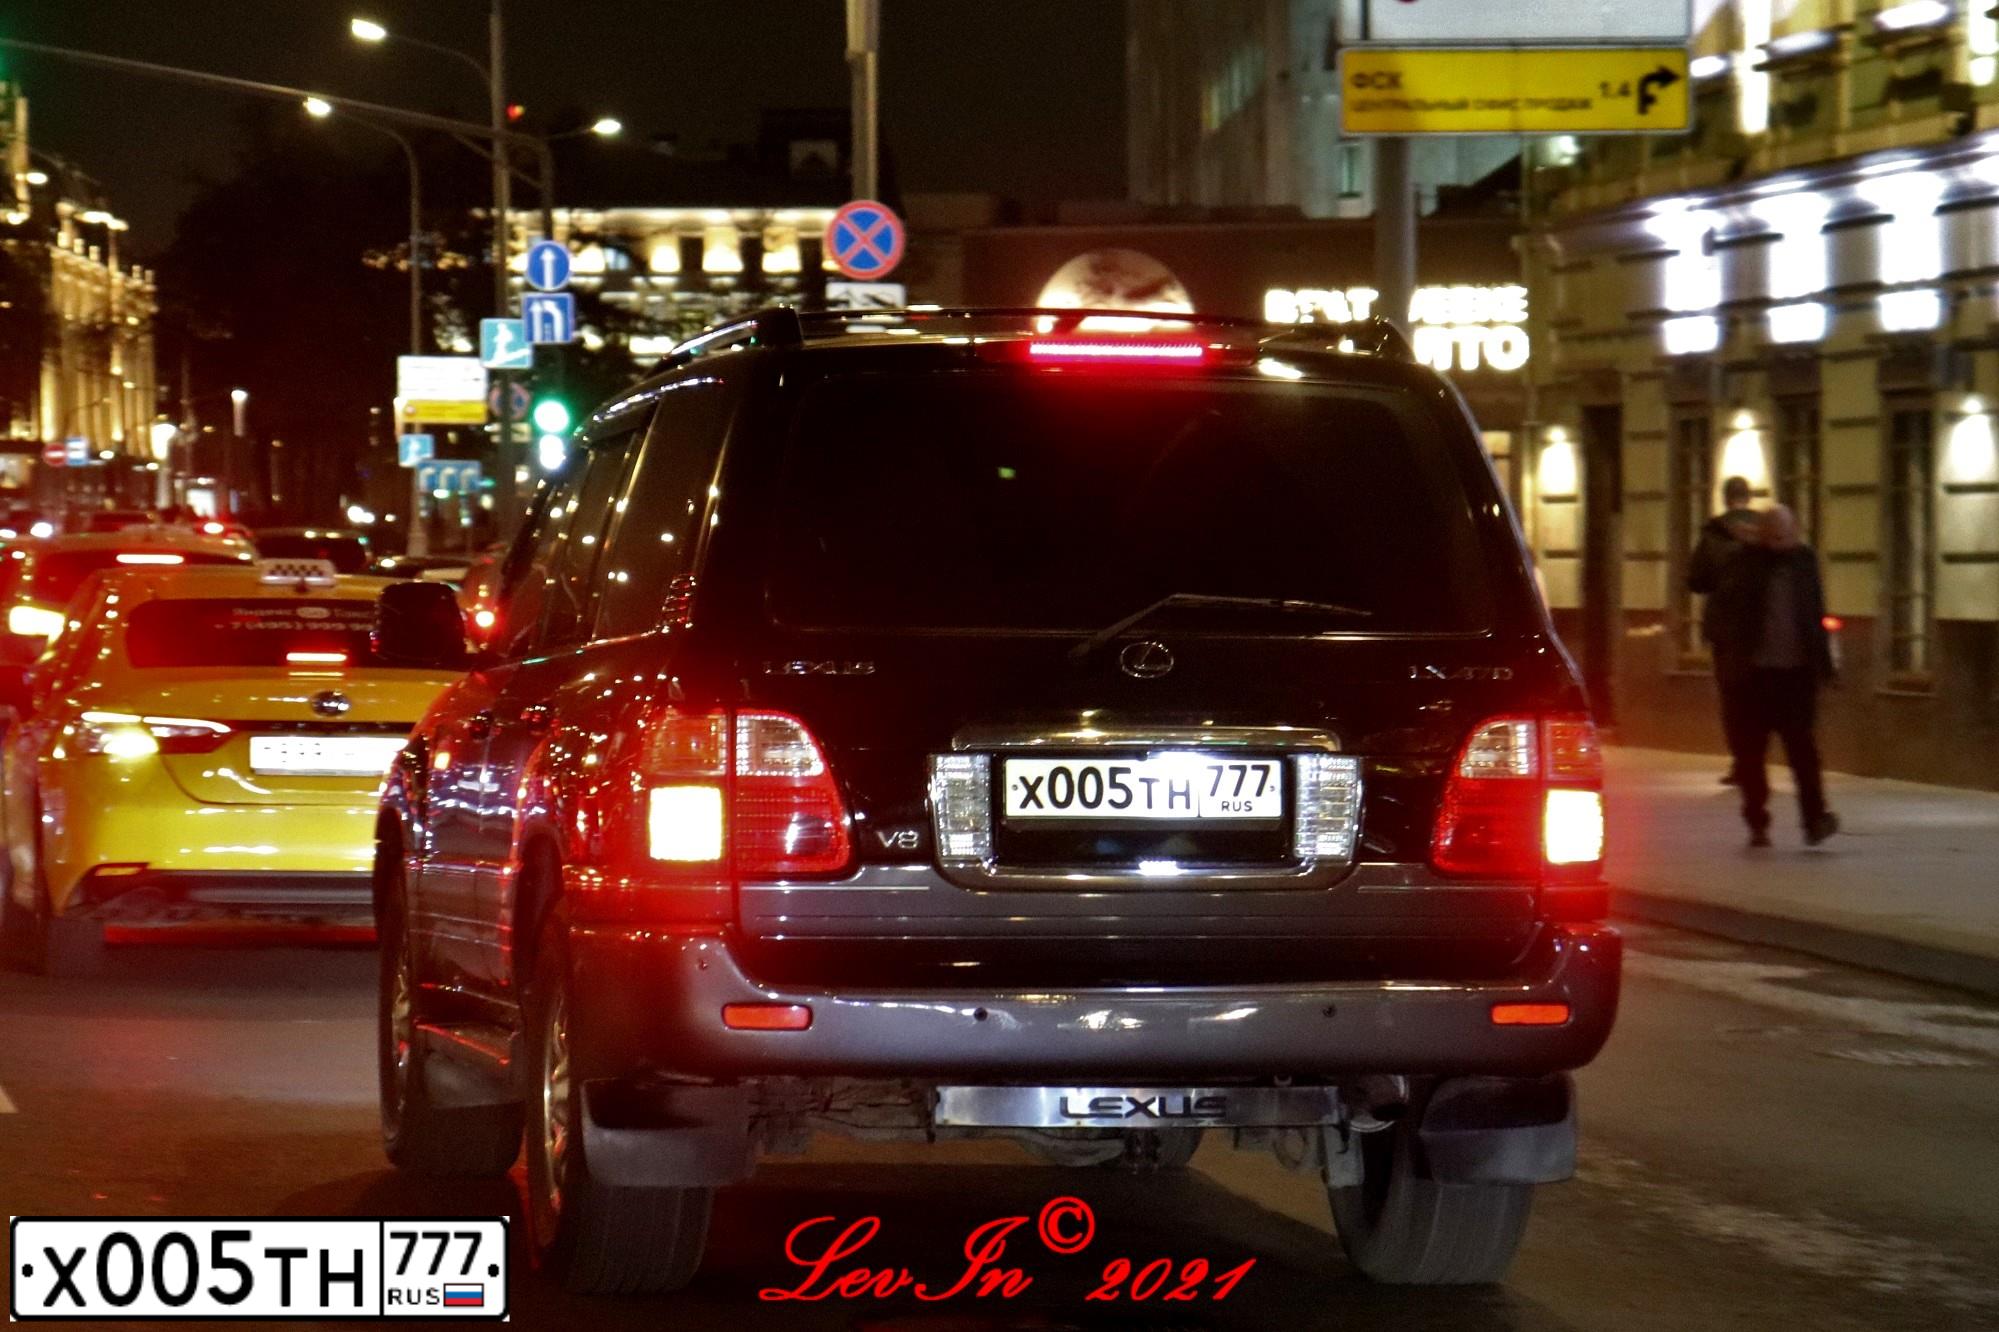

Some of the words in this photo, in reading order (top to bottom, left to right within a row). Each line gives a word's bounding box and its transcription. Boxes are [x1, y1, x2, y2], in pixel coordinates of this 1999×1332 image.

[1206, 764, 1271, 798] 777
[1221, 800, 1253, 813] RUS
[875, 830, 920, 849] V8
[1059, 1096, 1227, 1119] LEXUS
